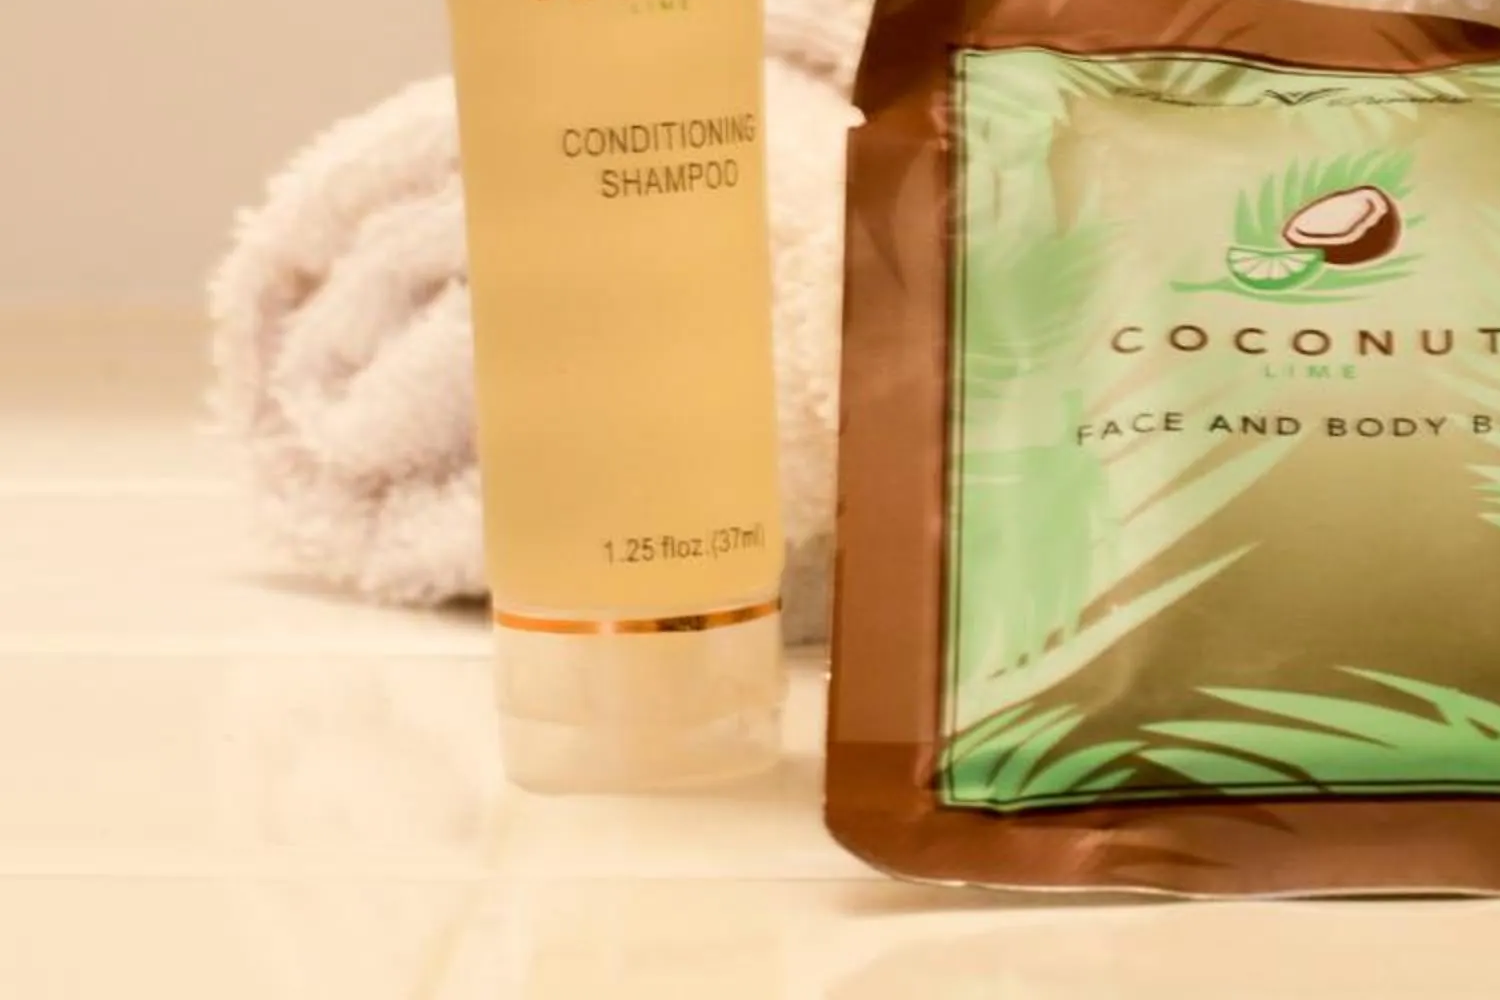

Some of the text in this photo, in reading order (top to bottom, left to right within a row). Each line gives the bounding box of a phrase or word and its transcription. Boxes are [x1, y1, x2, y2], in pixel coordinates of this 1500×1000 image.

[562, 113, 756, 158] CONDITIONING
[600, 159, 739, 199] SHAMPOO
[1263, 364, 1358, 380] LIME
[1076, 411, 1185, 446] FACE
[1208, 413, 1302, 437] AND
[1327, 415, 1448, 438] BODY
[603, 537, 655, 565] 1.25
